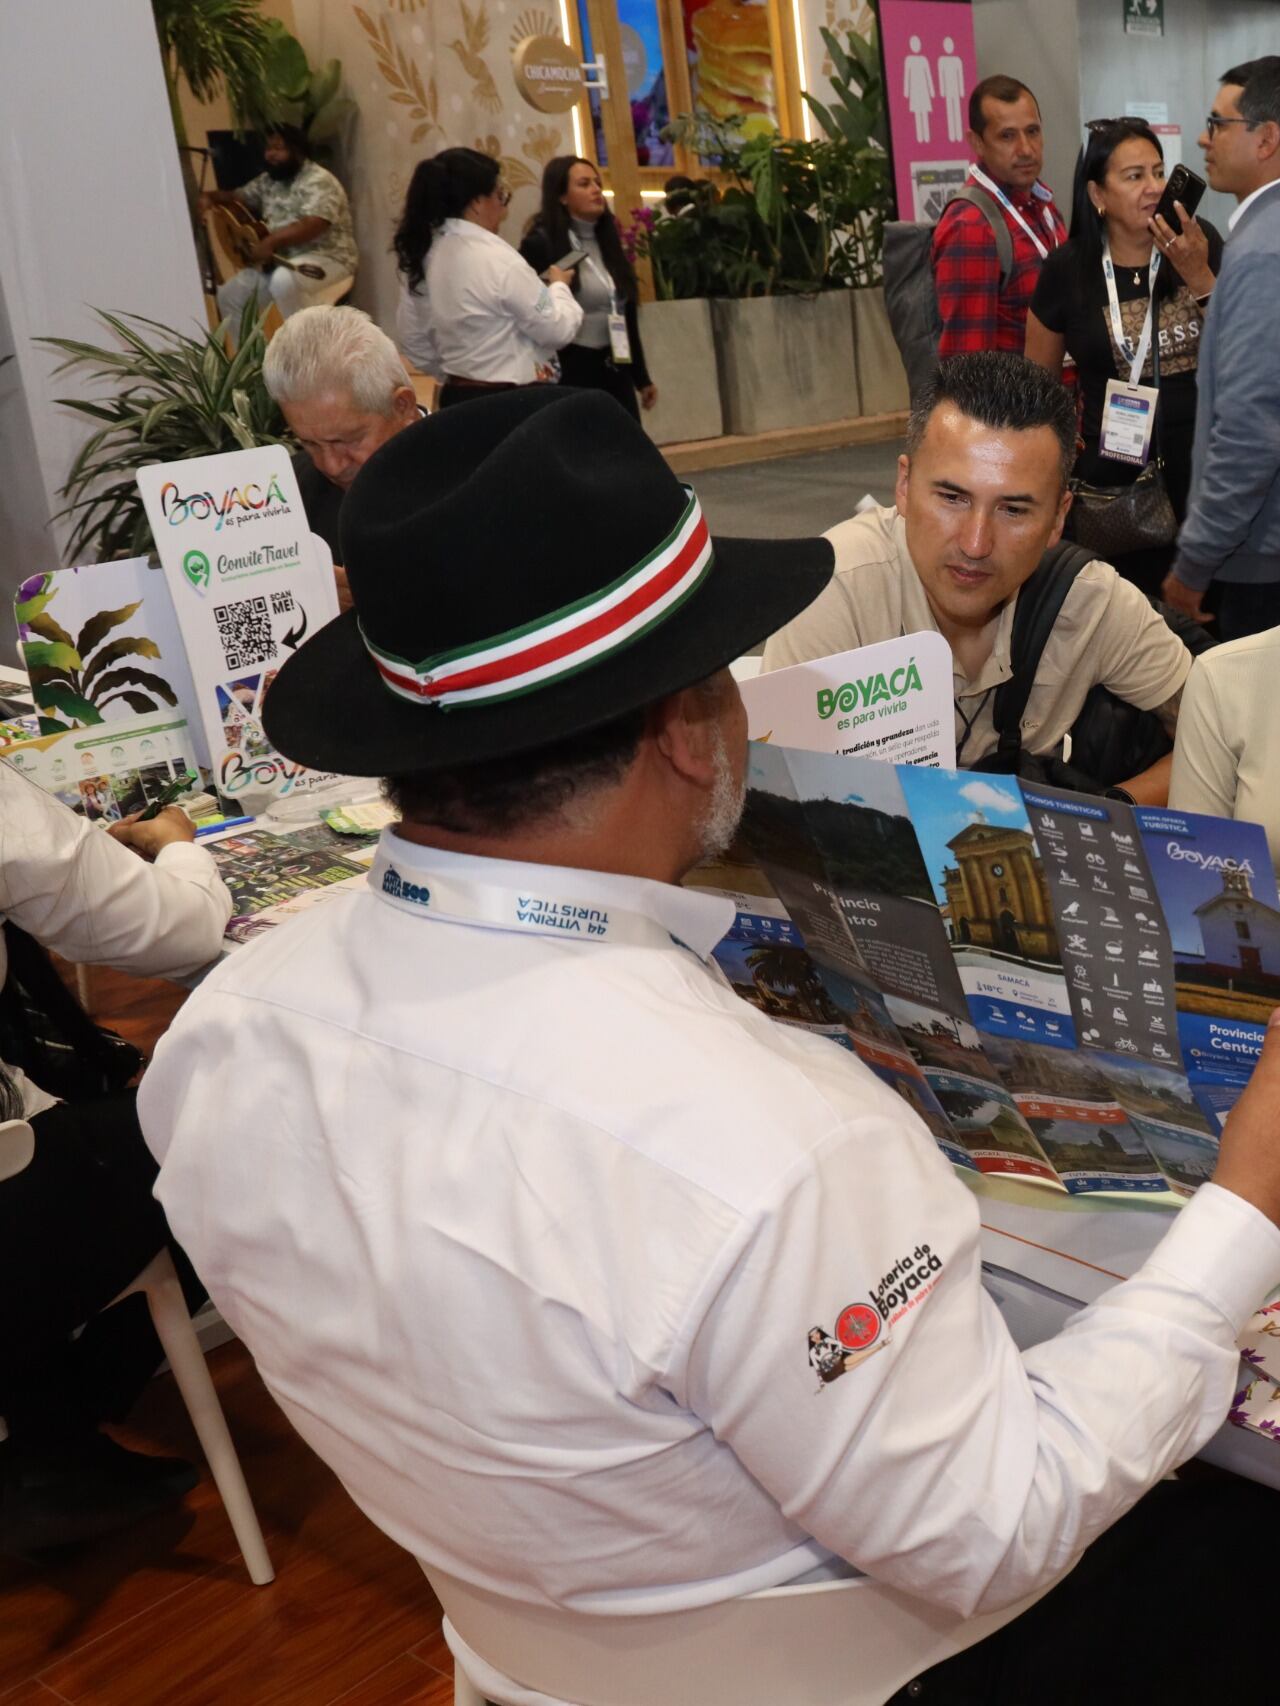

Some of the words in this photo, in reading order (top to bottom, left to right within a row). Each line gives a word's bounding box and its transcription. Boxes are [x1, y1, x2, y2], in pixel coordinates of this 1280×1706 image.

[1121, 321, 1200, 354] GESS
[161, 473, 288, 531] BOYACÁ
[237, 513, 260, 528] para
[217, 552, 263, 575] Convite
[261, 541, 299, 564] Travel
[269, 590, 292, 602] SCAN
[271, 598, 295, 615] ME!
[815, 656, 924, 721] BOYACÁ
[836, 717, 850, 731] es
[851, 708, 876, 729] para
[877, 699, 908, 719] vivirla
[842, 739, 875, 756] tradición
[875, 738, 881, 747] y
[881, 728, 914, 745] grandeza
[913, 751, 939, 765] esencia
[1166, 841, 1255, 874] BOYACÁ
[517, 909, 582, 934] VITRINA
[518, 896, 609, 924] TURISTICA
[586, 923, 608, 936] 44
[997, 973, 1031, 988] SAMACÁ
[1209, 1023, 1265, 1043] Provincia
[913, 1244, 931, 1259] de
[876, 1253, 943, 1321] Boyacá
